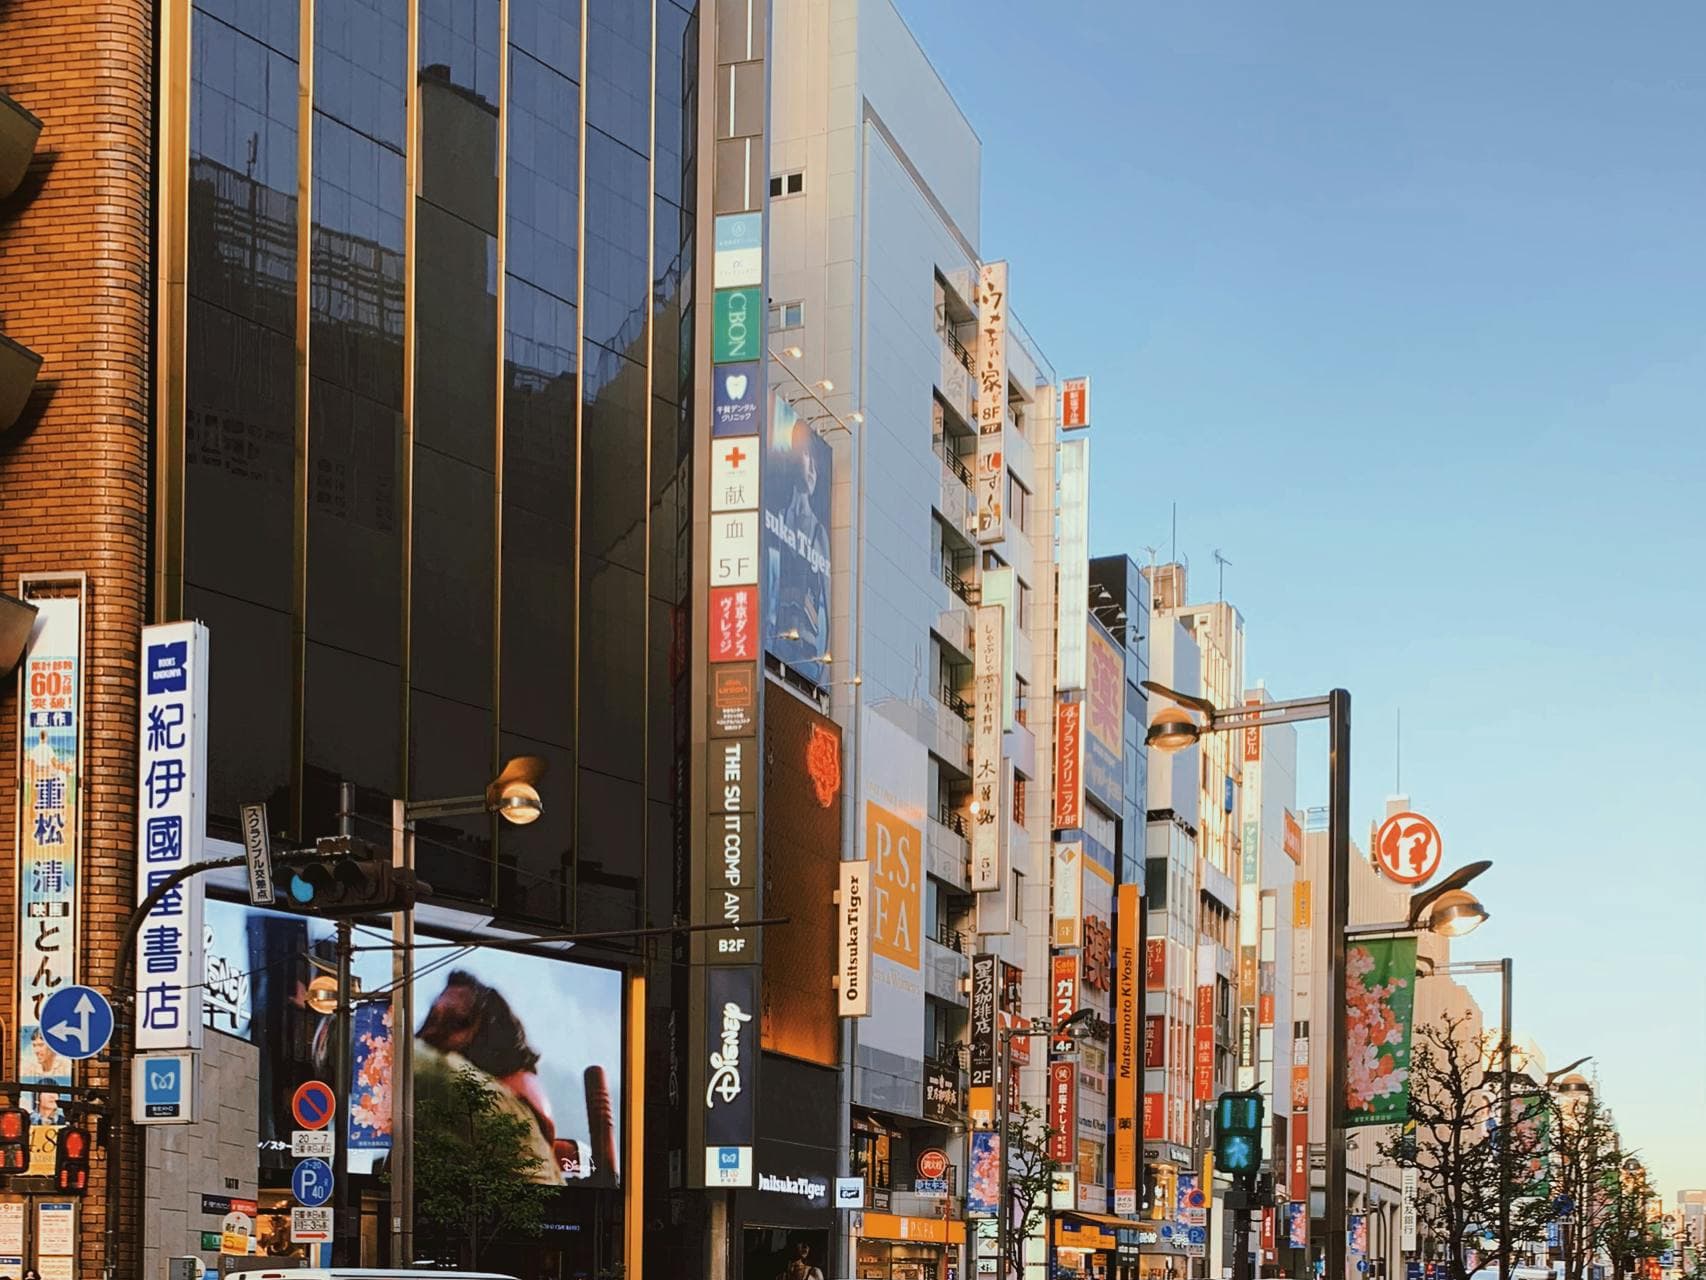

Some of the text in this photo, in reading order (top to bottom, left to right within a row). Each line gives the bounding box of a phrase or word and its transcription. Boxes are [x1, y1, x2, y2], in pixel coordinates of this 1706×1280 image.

[982, 406, 1001, 420] 8F
[725, 484, 745, 539] 献血
[724, 742, 741, 781] THE
[724, 786, 741, 832] SUIT
[142, 703, 186, 1030] 紀伊國屋書店
[247, 807, 269, 900] スクランブル交差点
[719, 939, 745, 952] B2F
[974, 959, 993, 1035] 星乃珈琲店
[706, 1002, 753, 1108] Disney
[1056, 1041, 1072, 1051] 4F
[973, 1071, 991, 1084] 2F
[302, 1169, 317, 1199] P
[312, 1186, 324, 1199] 40
